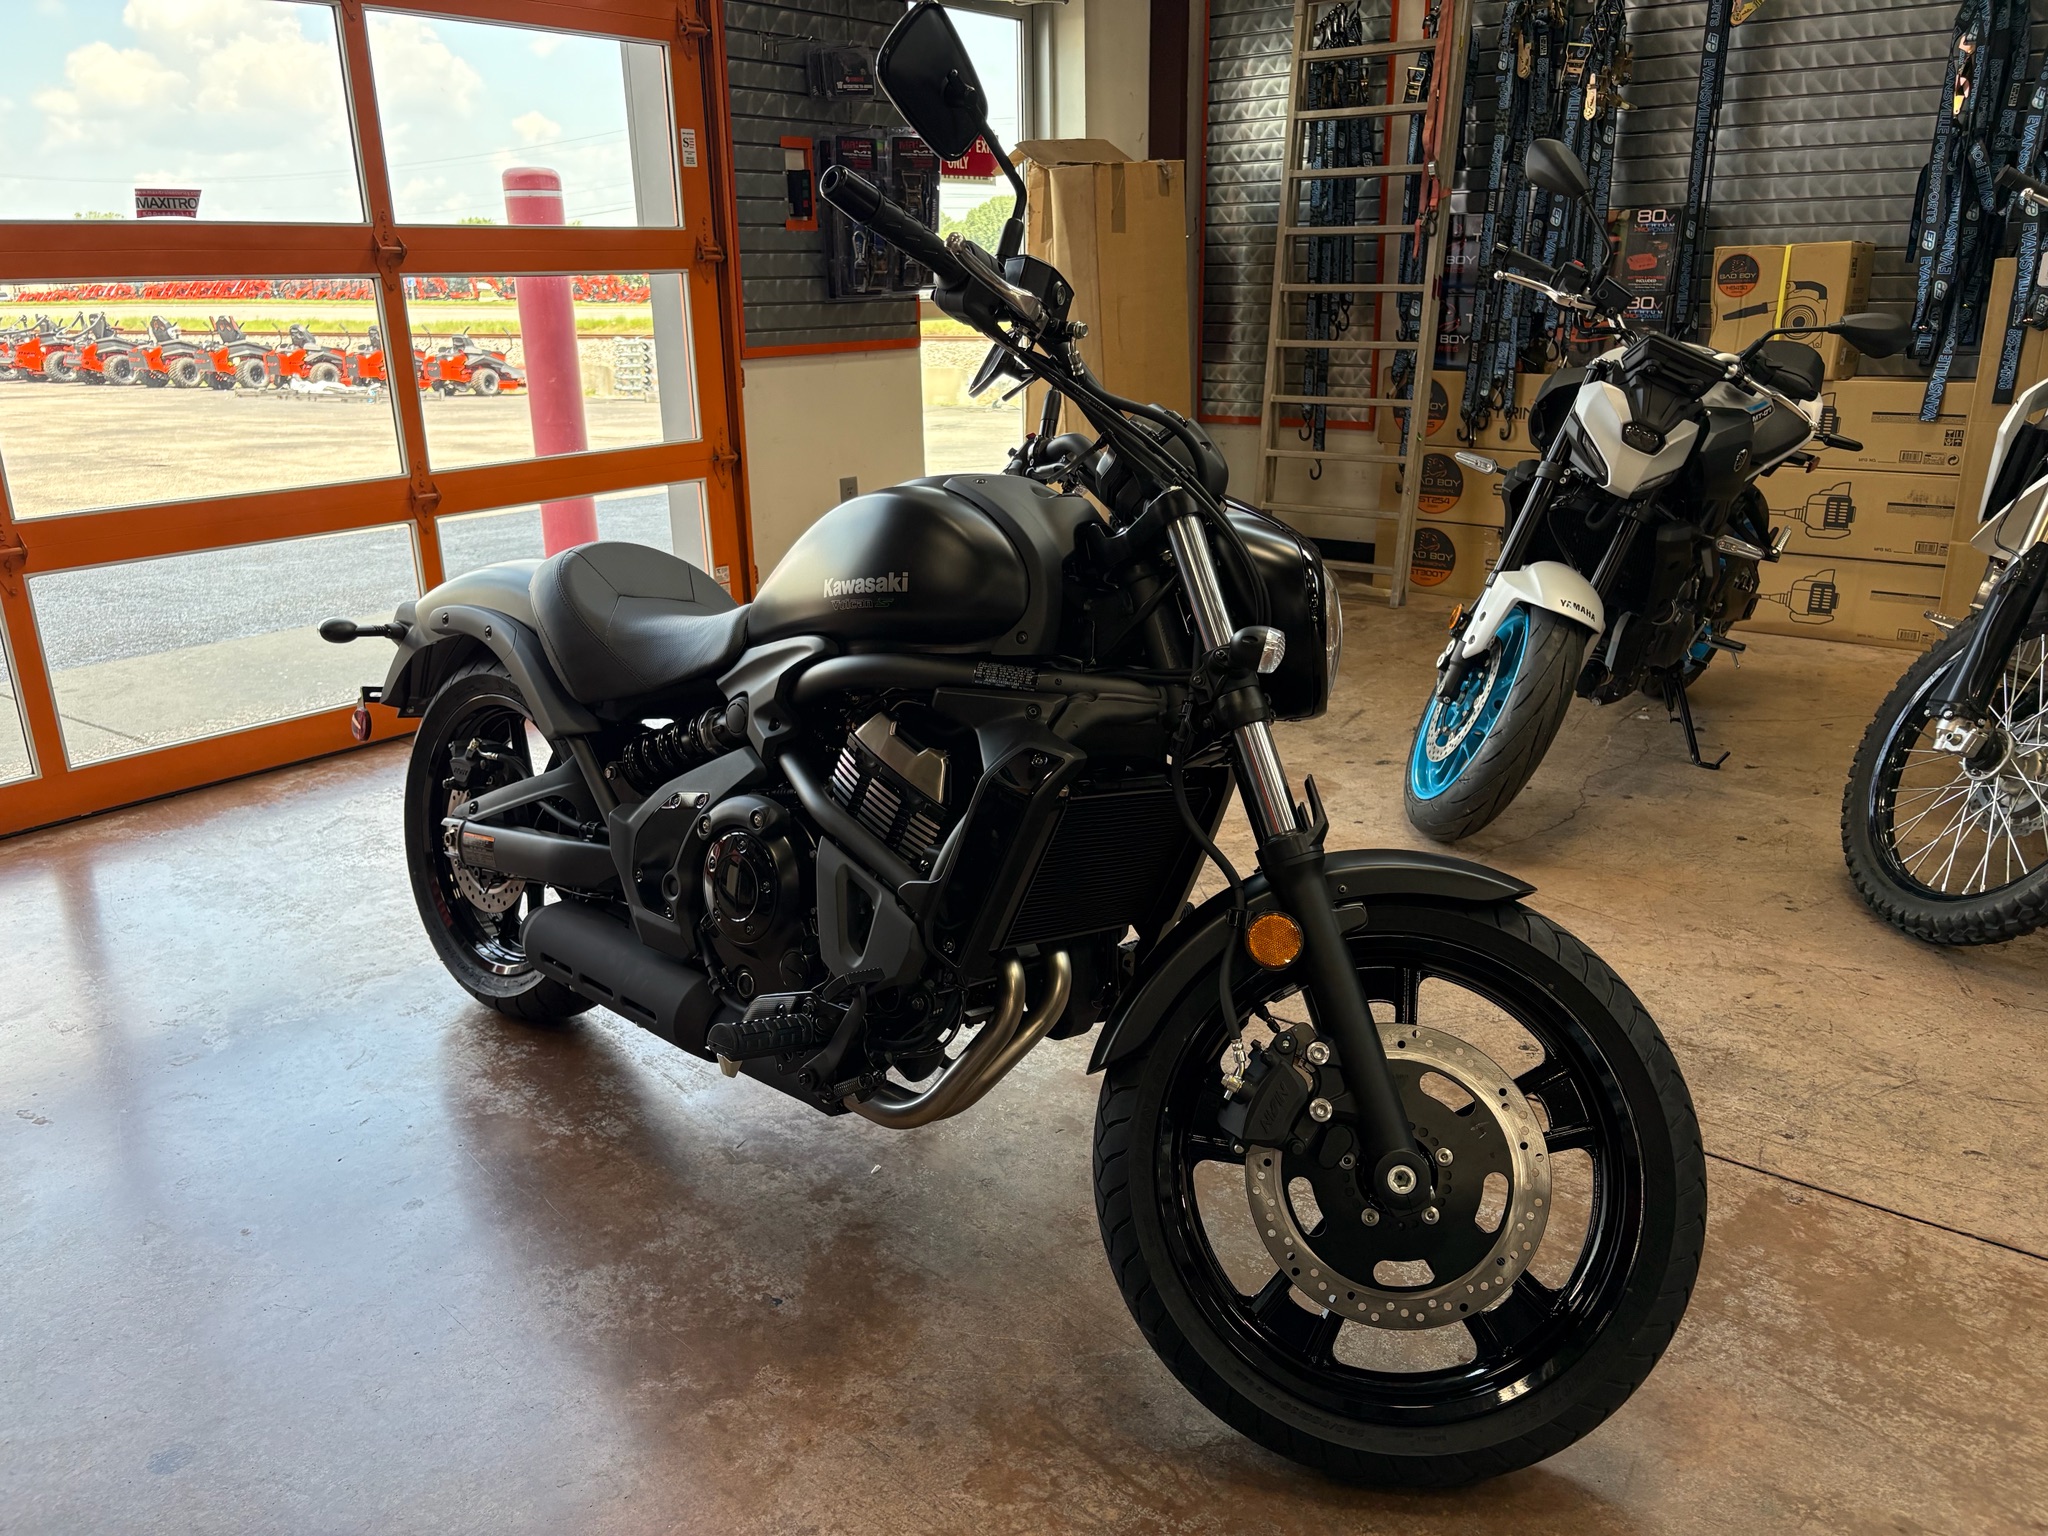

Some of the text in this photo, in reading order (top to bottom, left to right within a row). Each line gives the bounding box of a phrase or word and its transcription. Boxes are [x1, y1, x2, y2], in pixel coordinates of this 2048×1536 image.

[1689, 58, 1717, 215] EVANSVILLE POWERSPORTS
[2017, 115, 2041, 173] EVANSV
[1595, 149, 1612, 218] EVANSVILLE
[1925, 135, 1947, 224] POWERSPORTS
[136, 197, 199, 209] MAXITRO
[1922, 230, 1936, 251] EP
[1446, 255, 1476, 265] BOY
[1676, 244, 1694, 314] EVANSVILLE
[1439, 334, 1470, 345] BOY
[1920, 355, 1953, 422] VANSVILLE
[1752, 406, 1773, 422] MT-07
[1437, 478, 1461, 487] BOY
[1419, 495, 1450, 505] ST254
[1429, 553, 1453, 561] BOY
[823, 571, 909, 598] Kawasaki
[831, 598, 873, 611] Vulcan
[1560, 599, 1596, 622] YAMAHA
